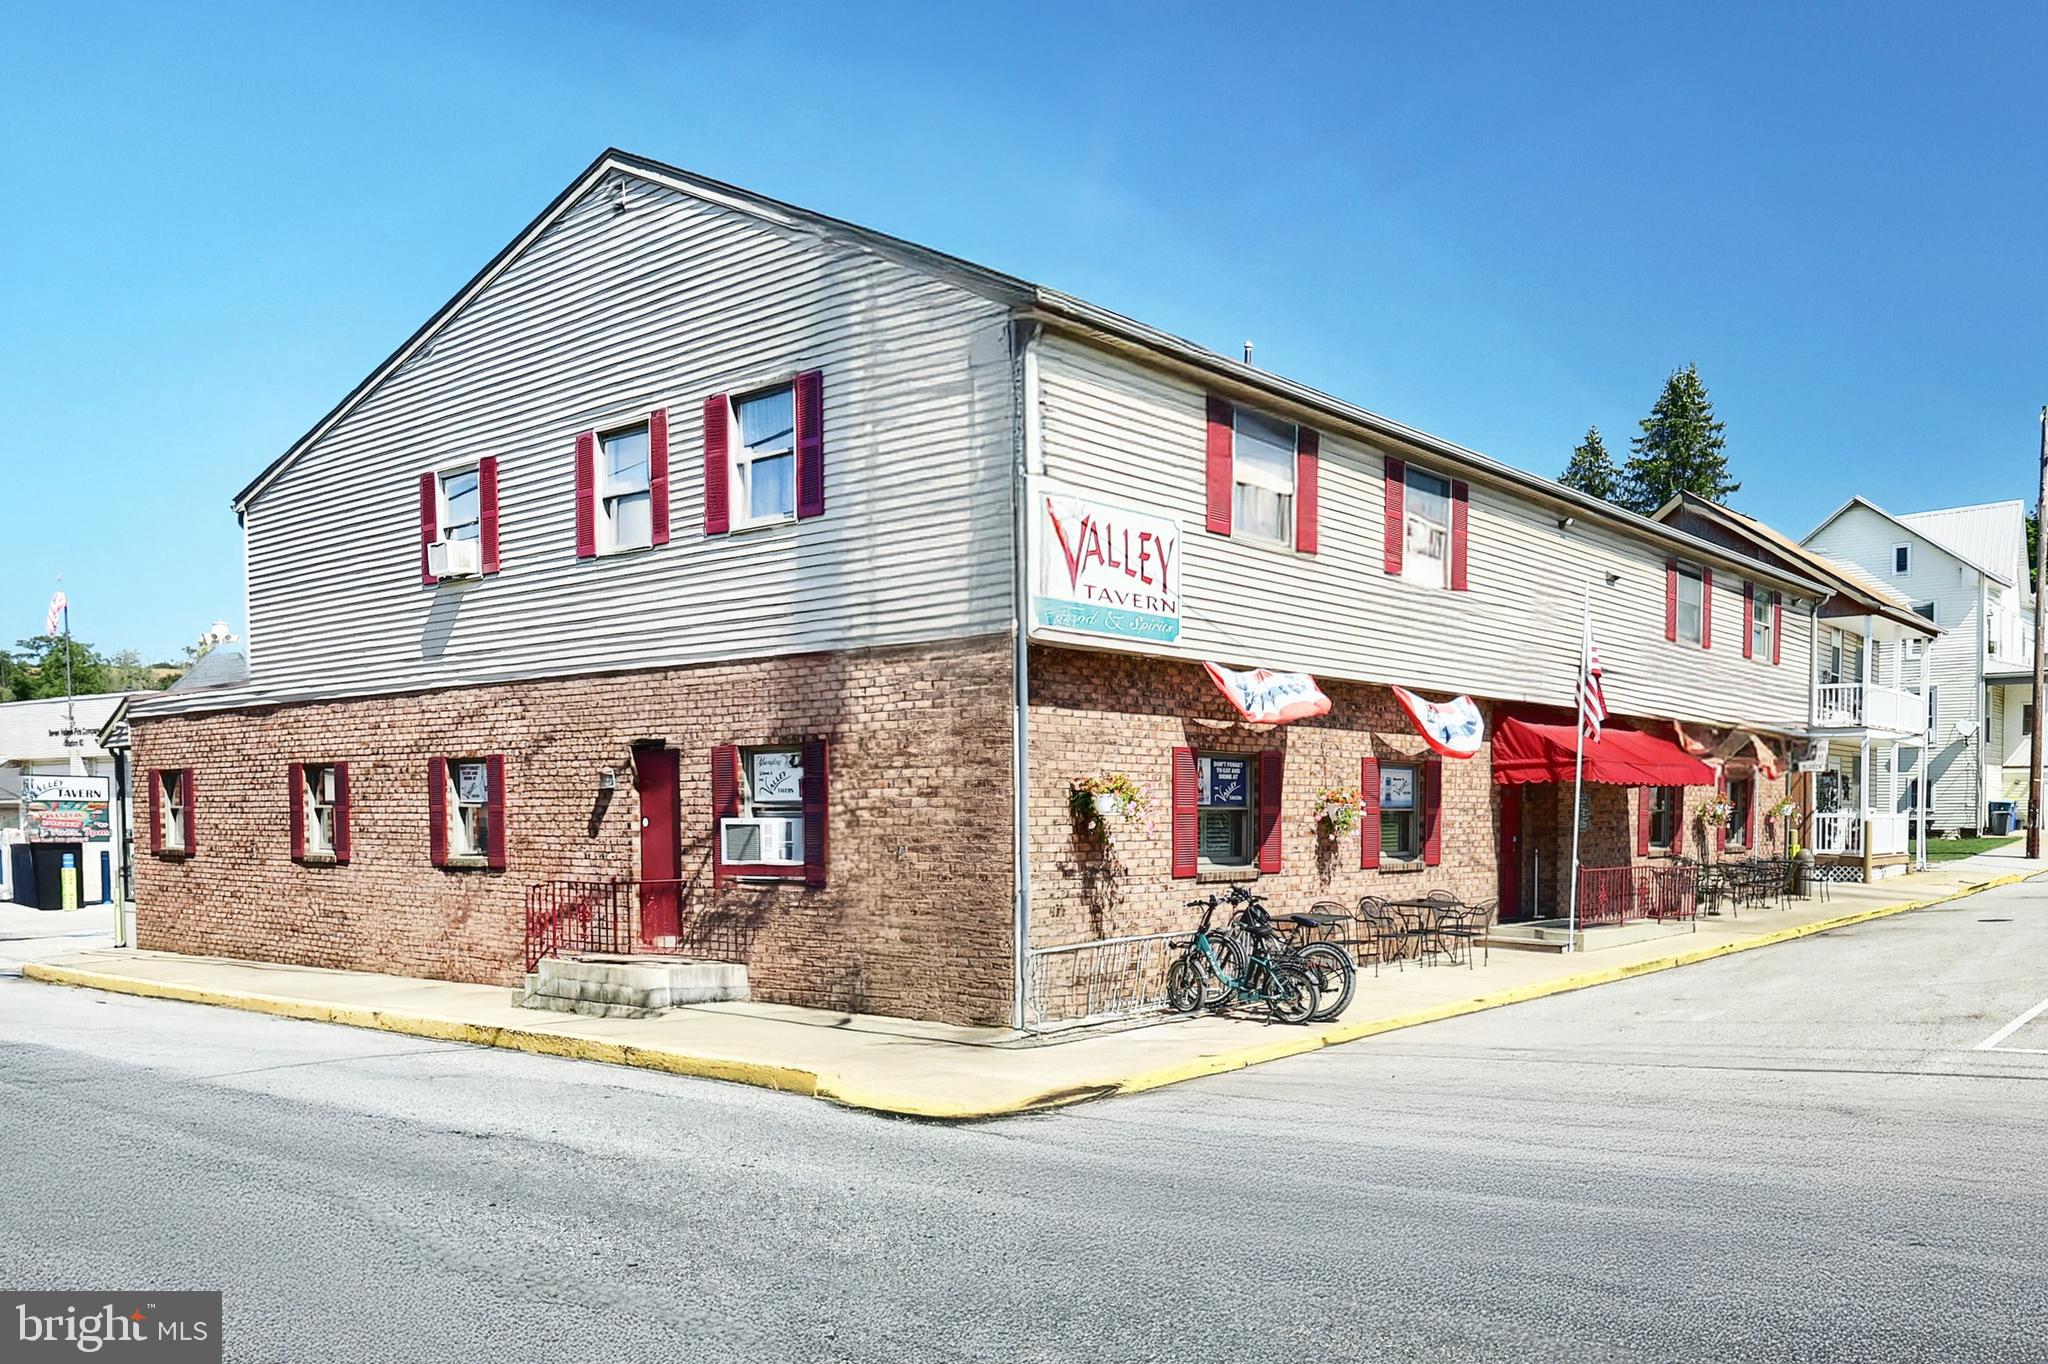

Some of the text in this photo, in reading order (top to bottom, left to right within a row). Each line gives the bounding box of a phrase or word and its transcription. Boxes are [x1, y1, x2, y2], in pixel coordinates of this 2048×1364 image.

[1045, 497, 1175, 595] VALLEY
[1083, 584, 1176, 614] TAVERN
[1104, 610, 1125, 631] &
[1129, 616, 1174, 633] Spirits
[59, 789, 102, 798] TAVERN
[759, 771, 787, 795] VALLEY
[1214, 781, 1237, 802] VALLEY
